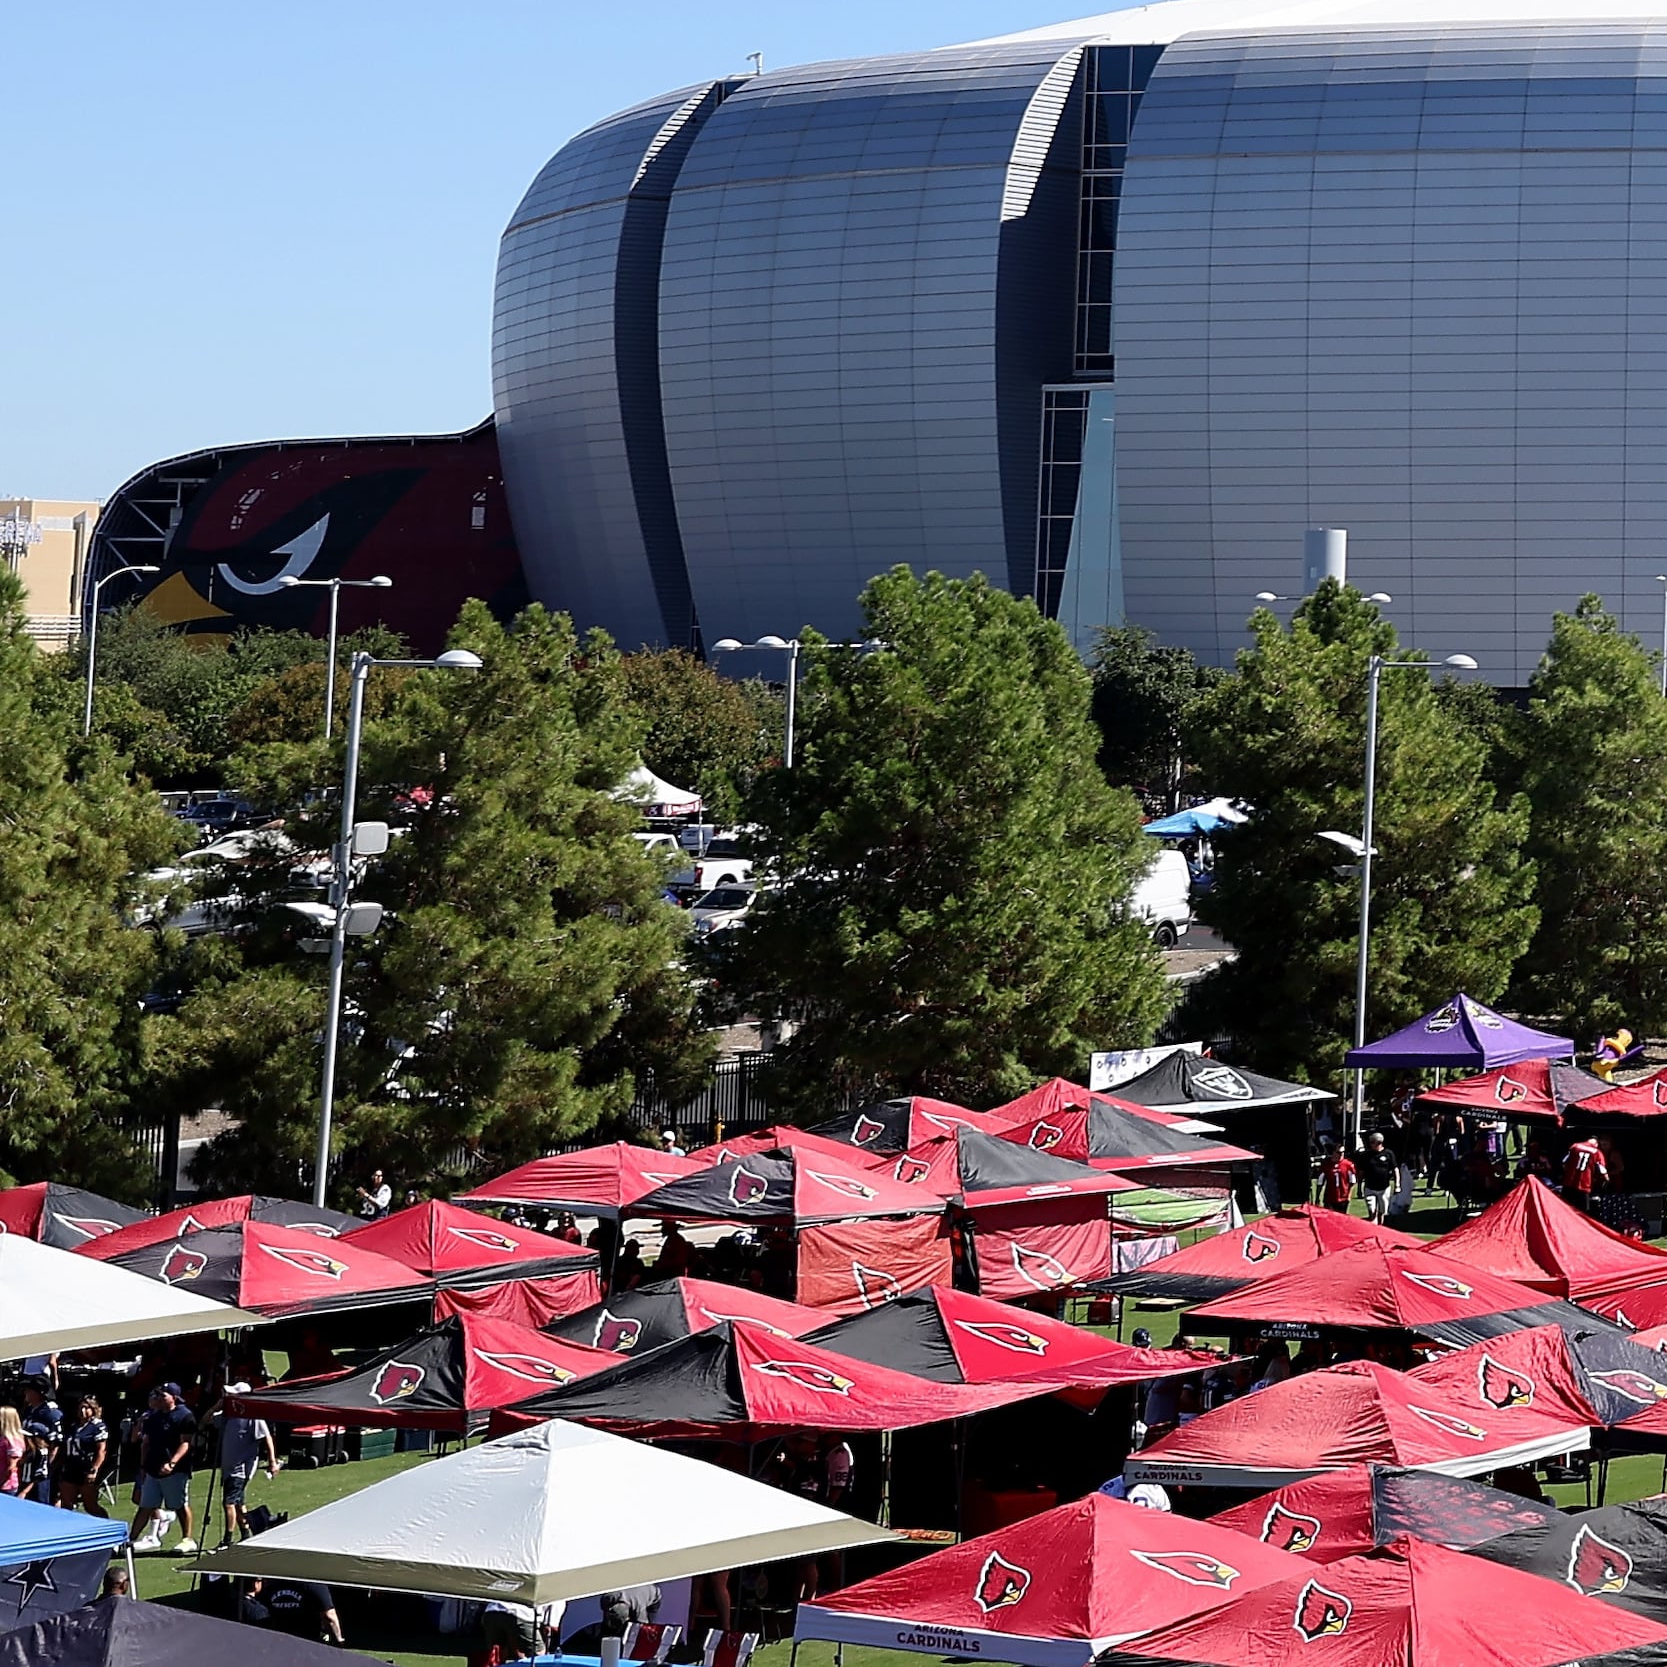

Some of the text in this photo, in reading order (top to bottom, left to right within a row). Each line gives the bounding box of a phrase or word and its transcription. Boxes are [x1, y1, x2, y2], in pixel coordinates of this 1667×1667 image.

[1271, 1322, 1308, 1330] ARIZONA
[1260, 1329, 1320, 1339] CARDINALS
[1134, 1471, 1203, 1481] CARDINALS
[914, 1624, 965, 1638] ARIZONA
[896, 1632, 981, 1653] CARDINALS
